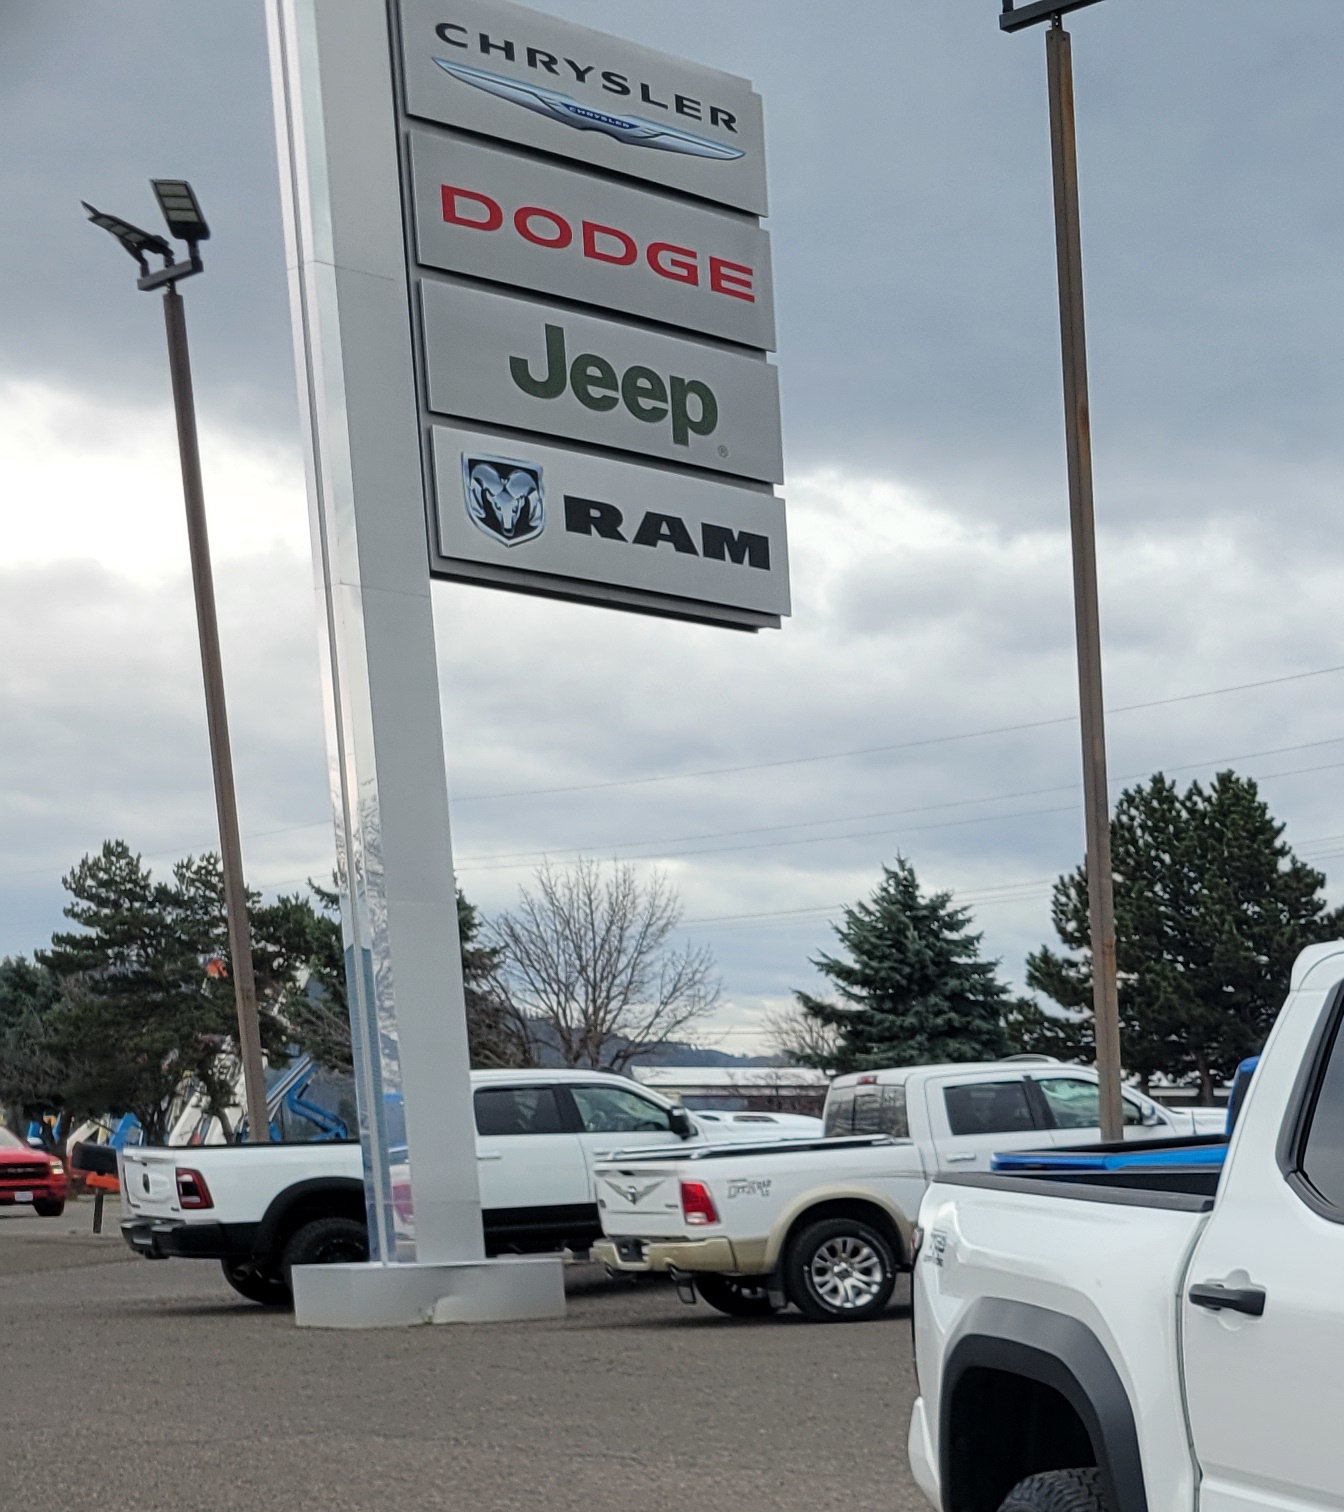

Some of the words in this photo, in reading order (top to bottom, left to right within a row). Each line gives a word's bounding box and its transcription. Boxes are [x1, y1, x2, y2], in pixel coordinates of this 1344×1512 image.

[435, 22, 738, 133] CHRYSLER
[569, 105, 630, 128] CHRYSLER
[441, 184, 755, 303] DODGE
[509, 324, 718, 445] Jeep
[563, 494, 770, 570] RAM
